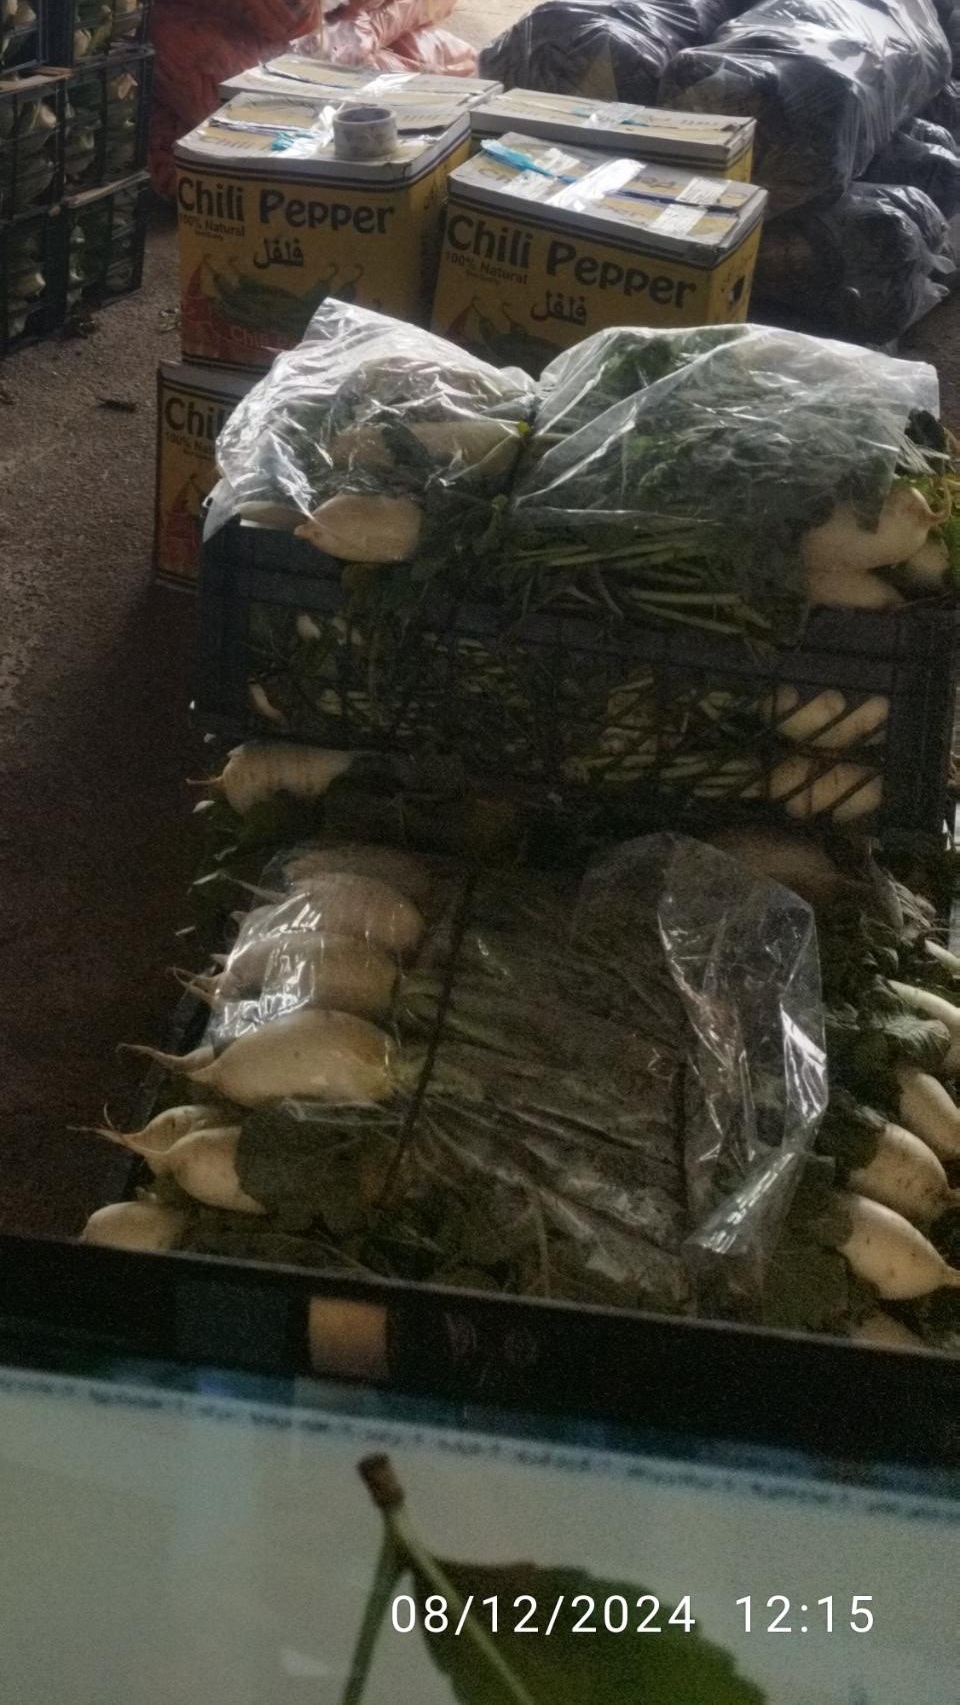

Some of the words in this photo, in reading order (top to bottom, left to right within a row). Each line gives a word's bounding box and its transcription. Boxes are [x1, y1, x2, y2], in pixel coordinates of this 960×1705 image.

[178, 176, 244, 223] Chili
[259, 188, 395, 235] Pepper
[204, 219, 246, 238] Natural
[253, 237, 305, 270] فلفل
[446, 215, 534, 269] Chili
[546, 240, 697, 309] Pepper
[480, 261, 528, 285] Natural
[530, 289, 587, 327] فلفل
[165, 397, 226, 441] Chil
